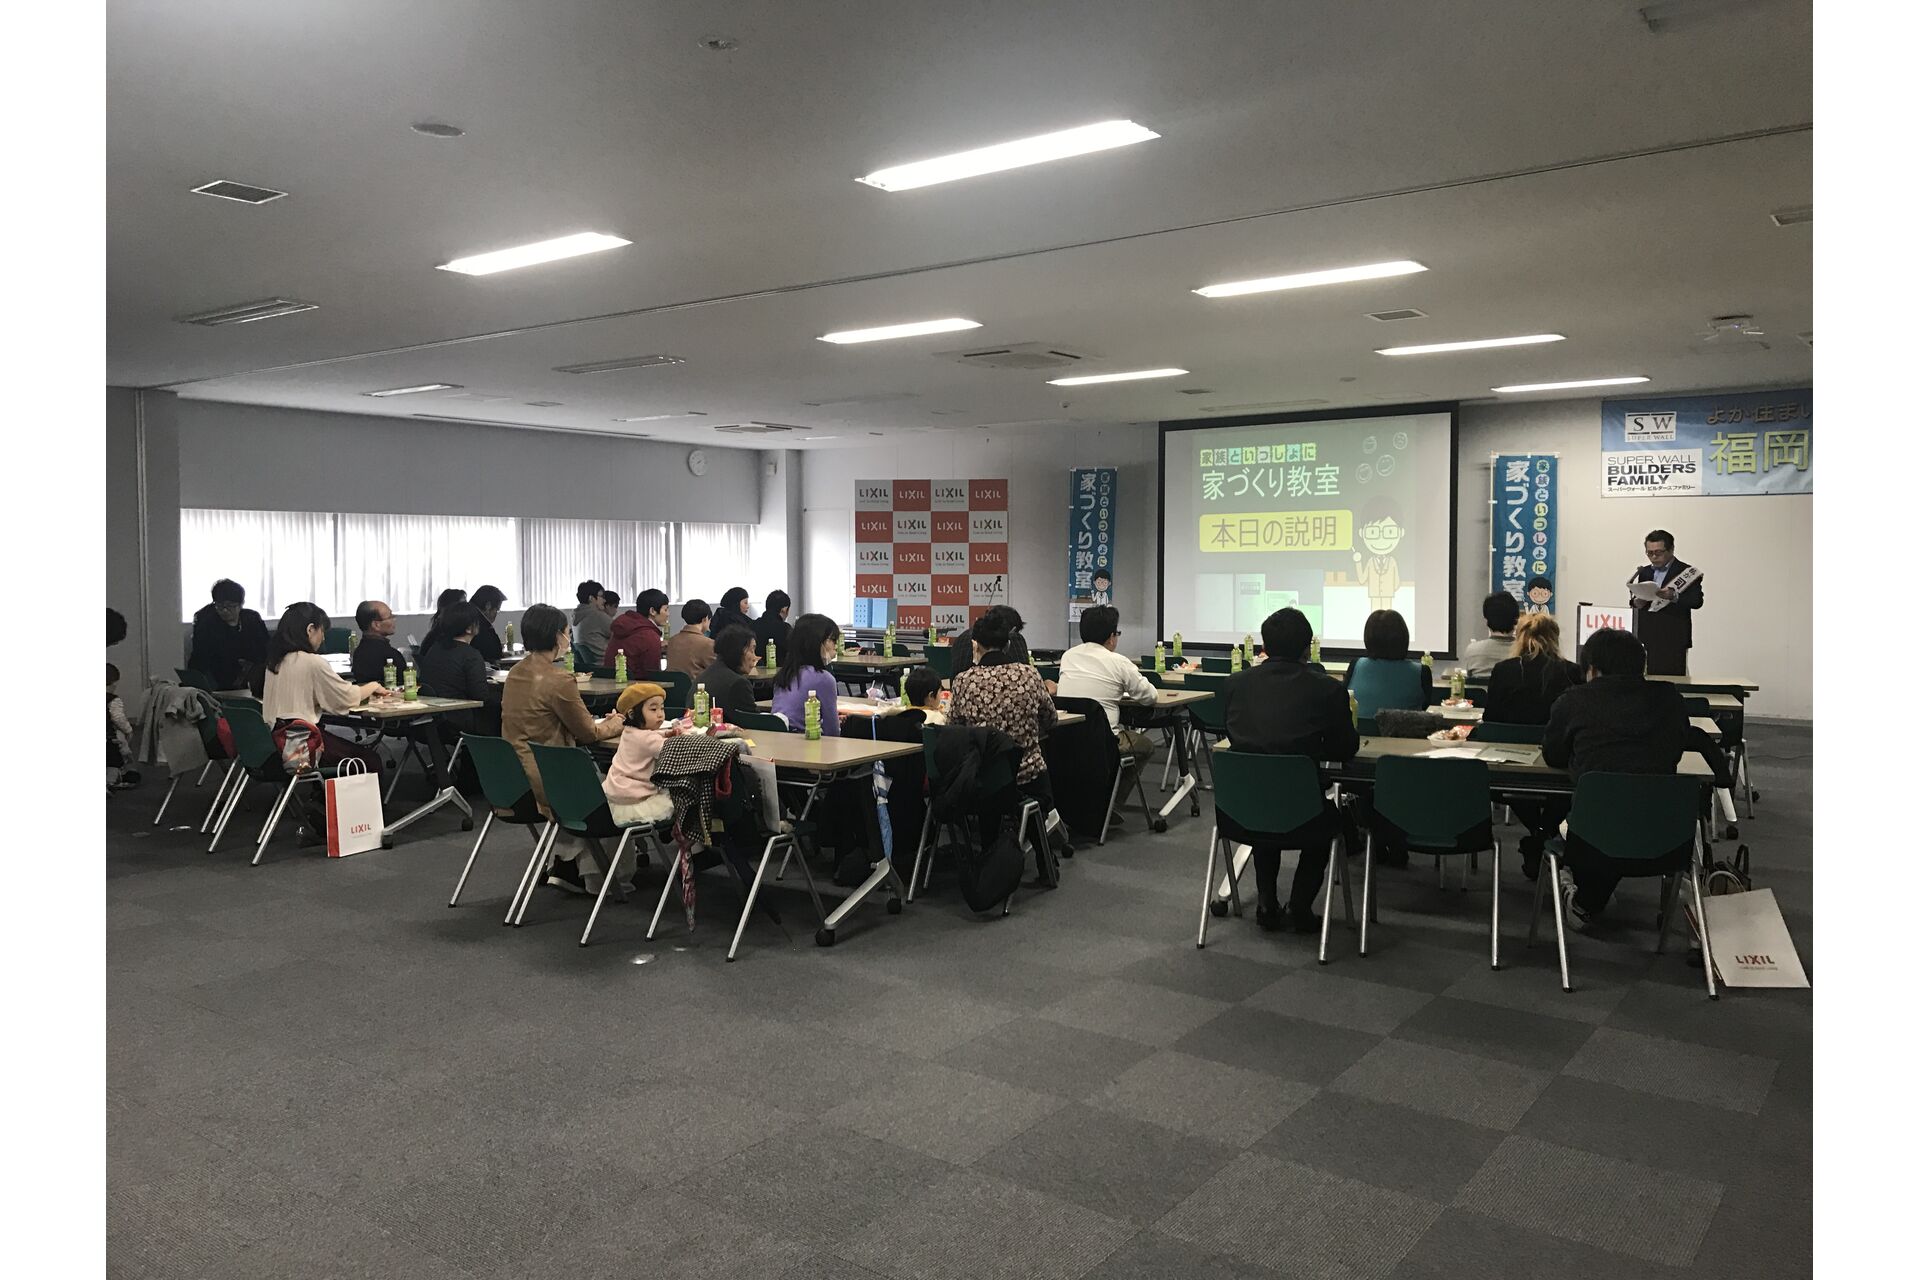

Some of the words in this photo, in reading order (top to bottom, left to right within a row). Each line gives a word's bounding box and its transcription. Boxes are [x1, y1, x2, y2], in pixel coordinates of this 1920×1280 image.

[1200, 443, 1317, 467] 家族といっしょに
[1709, 431, 1809, 475] 福岡
[1607, 455, 1654, 465] SUPER
[1657, 454, 1696, 464] WALL
[1607, 463, 1697, 475] BUILDERS
[1202, 463, 1340, 500] 家づくり教室
[1607, 474, 1670, 486] FAMILY
[859, 487, 888, 498] LIXIL
[899, 489, 925, 500] LIXIL
[935, 487, 964, 498] LIXIL
[975, 489, 1001, 499] LIXIL
[861, 521, 887, 532] LIXIL
[897, 519, 927, 530] LIXIL
[937, 521, 963, 532] LIXIL
[973, 519, 1003, 530] LIXIL
[1075, 472, 1097, 589] 家づくり教室
[1211, 515, 1337, 549] 本日の説明
[860, 550, 889, 561] LIXIL
[899, 552, 925, 562] LIXIL
[935, 550, 965, 561] LIXIL
[975, 552, 1001, 562] LIXIL
[861, 584, 888, 594] LIXIL
[897, 582, 927, 593] LIXIL
[937, 584, 963, 594] LIXIL
[973, 582, 1003, 593] LIXIL
[899, 615, 926, 625] LIXIL
[935, 613, 965, 624] LIXIL
[1586, 613, 1626, 631] LIXIL
[351, 823, 372, 834] LIXIL
[1735, 955, 1776, 965] LIXIL
